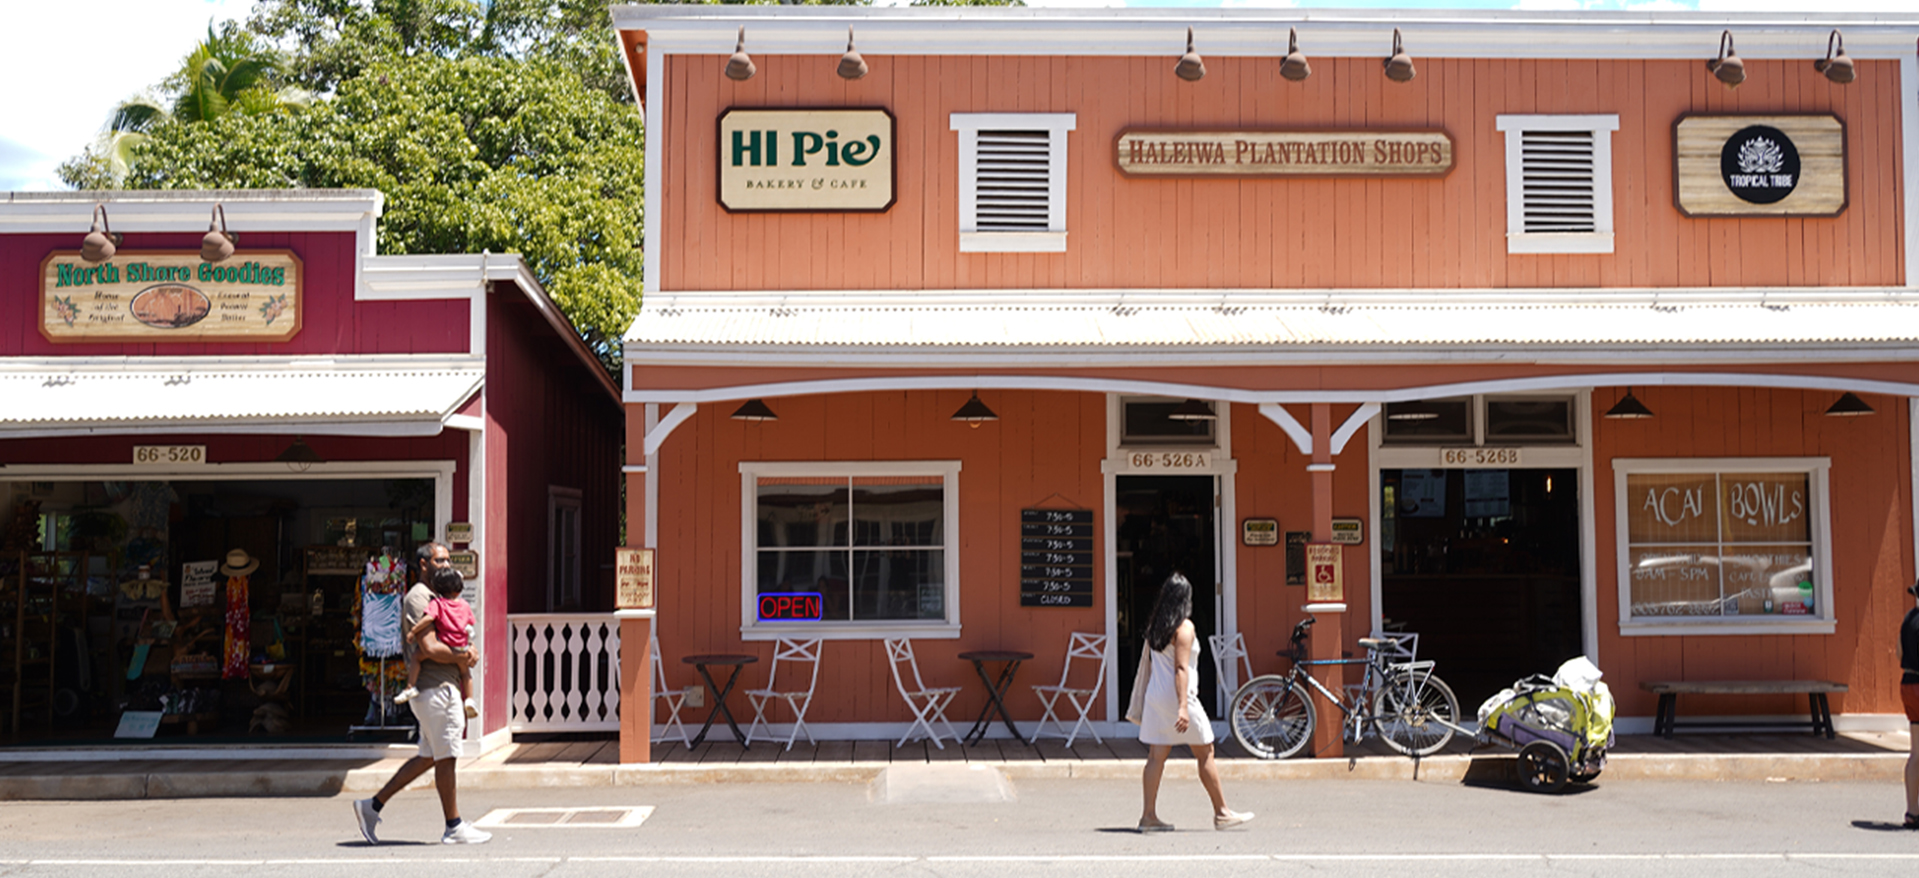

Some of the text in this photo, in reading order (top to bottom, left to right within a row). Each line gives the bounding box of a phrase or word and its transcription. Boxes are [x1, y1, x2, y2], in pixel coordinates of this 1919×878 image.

[731, 129, 881, 167] HI Pie
[1128, 139, 1443, 165] HALEIWA PLANTATION SHOPS
[746, 178, 868, 190] BAKERY & CAFE
[1729, 174, 1793, 188] TROPICAL TRIBE
[55, 261, 286, 288] North Shore Goodies
[137, 446, 202, 462] 66-520
[1445, 449, 1518, 464] 66-526B
[1730, 481, 1803, 528] BOWLS
[760, 596, 820, 619] OPEN
